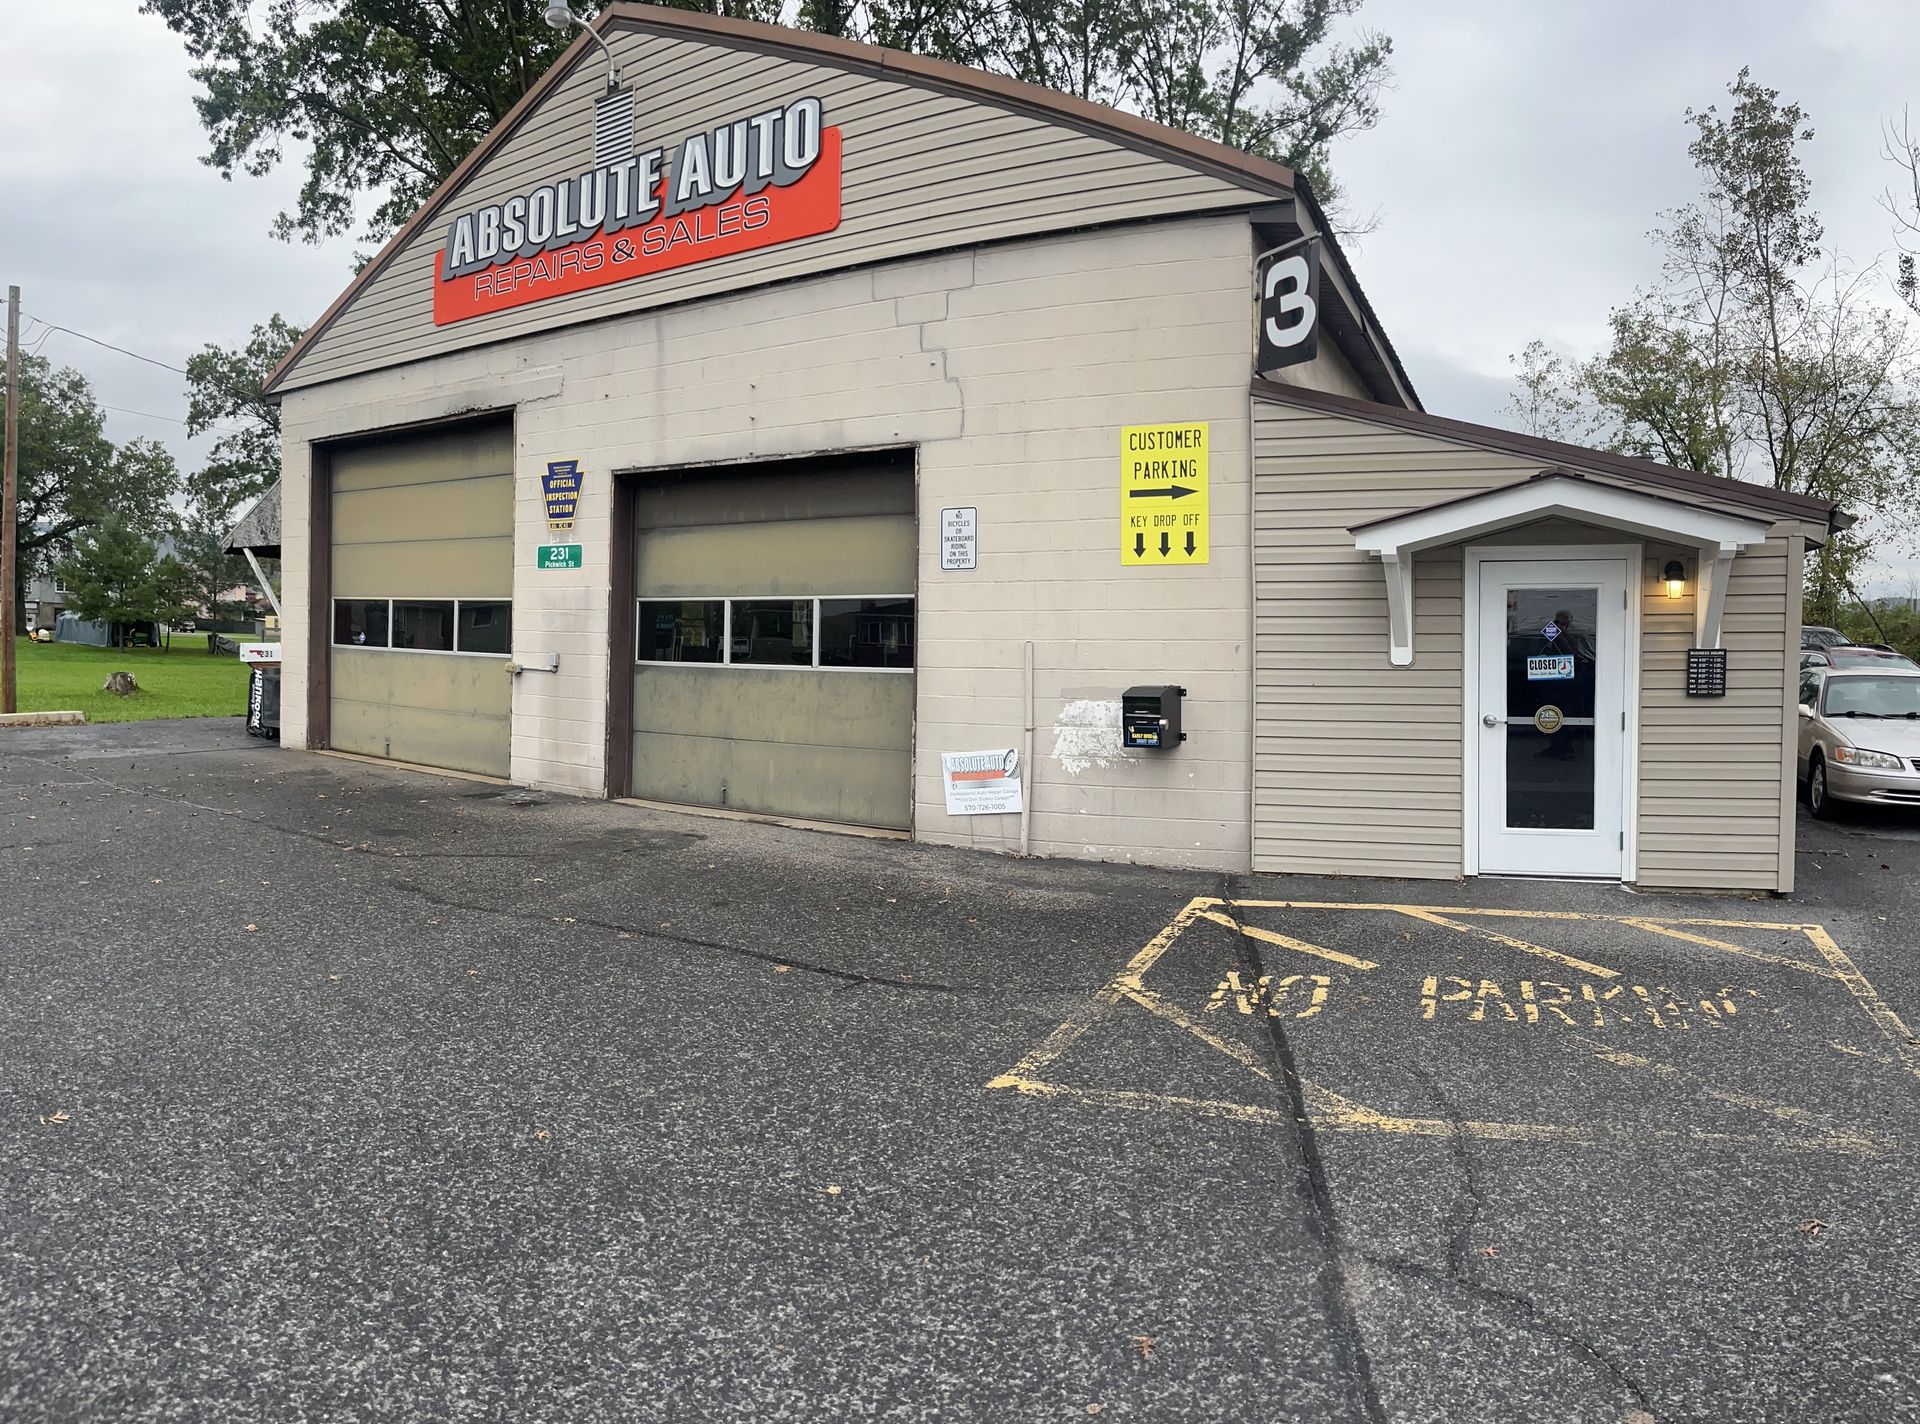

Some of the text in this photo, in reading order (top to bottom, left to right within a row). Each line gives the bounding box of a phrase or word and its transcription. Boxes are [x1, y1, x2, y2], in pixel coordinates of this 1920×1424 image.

[446, 96, 823, 271] ABSOLUTE AUTO
[474, 197, 771, 300] REPAIRS & SALES
[1265, 255, 1317, 347] 3
[1129, 429, 1202, 451] CUSTOMER
[1134, 459, 1197, 480] PARKING
[549, 479, 576, 489] OFFICIAL
[546, 491, 578, 501] INSPECTION
[549, 504, 573, 514] STATION
[1130, 513, 1200, 527] KEY DROP OFF
[550, 548, 569, 560] 231
[260, 650, 273, 658] 231
[1529, 659, 1557, 671] CLOSED
[951, 754, 1005, 771] ABSOLUTE AUTO
[1204, 971, 1331, 1018] NO
